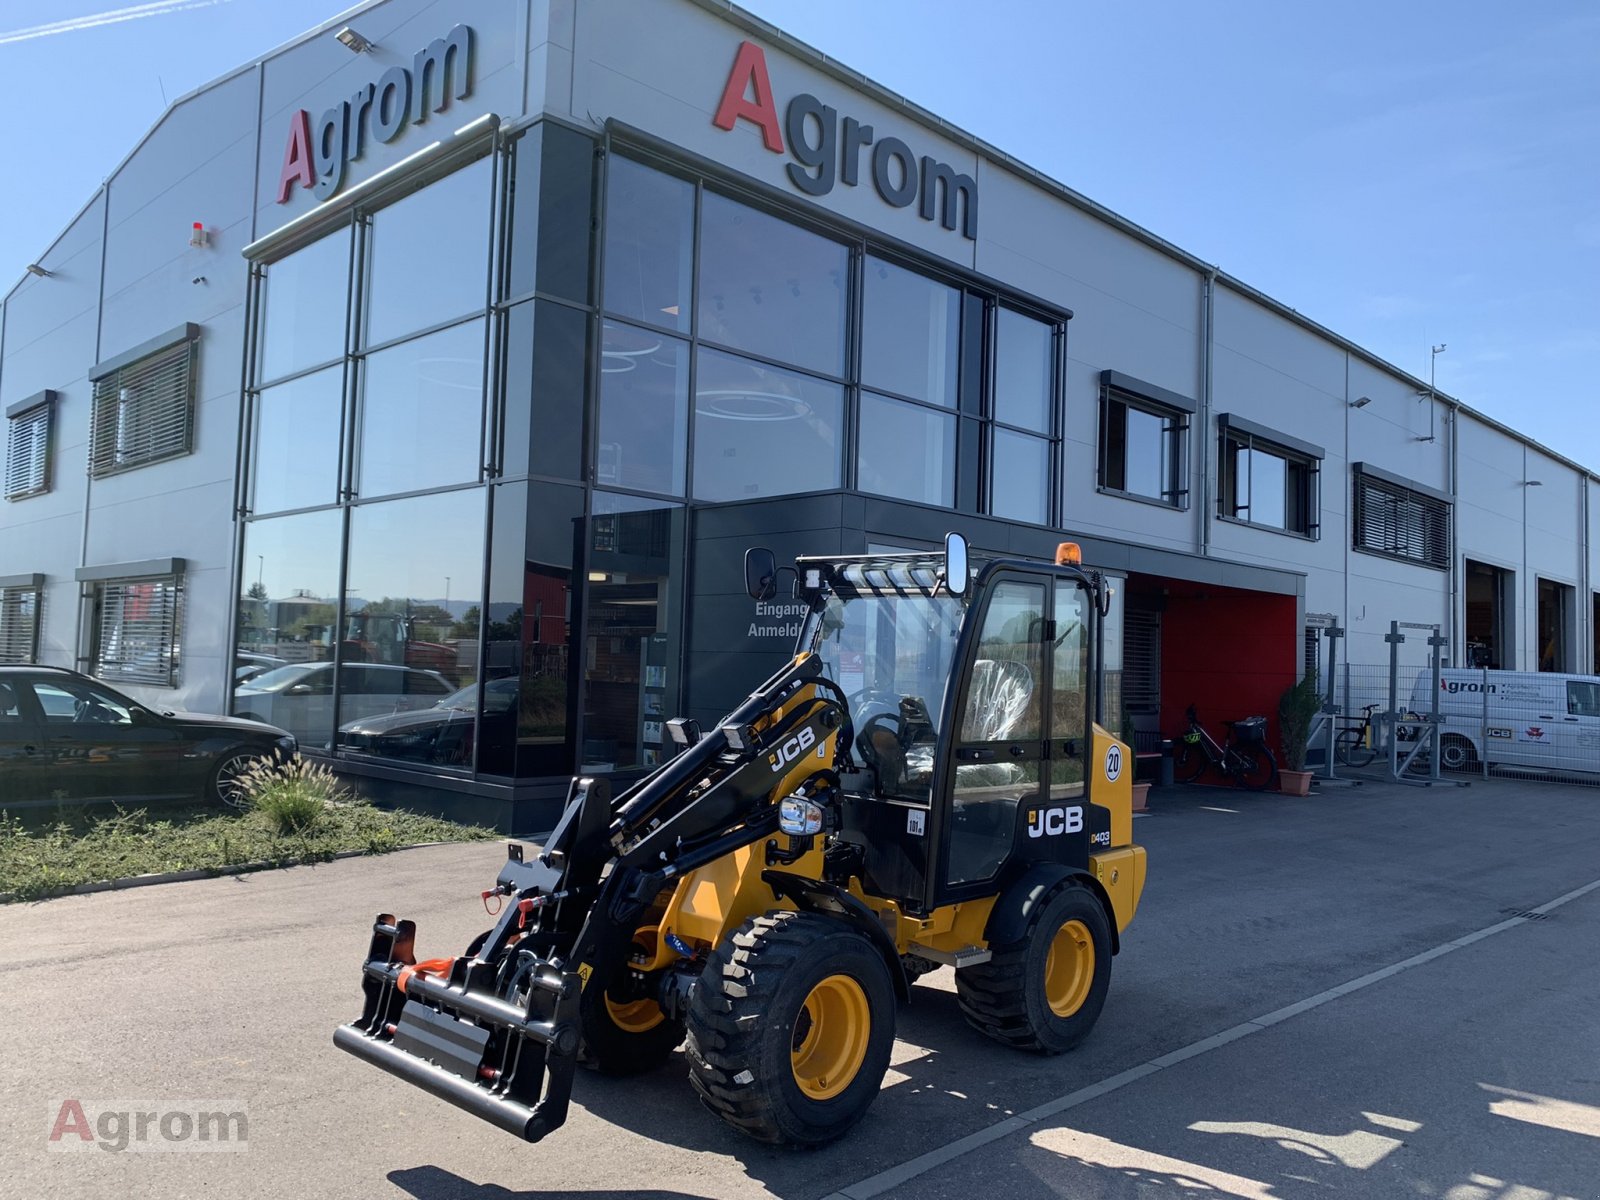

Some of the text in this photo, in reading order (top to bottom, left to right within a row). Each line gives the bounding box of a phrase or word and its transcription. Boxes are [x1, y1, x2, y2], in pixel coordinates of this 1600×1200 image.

[277, 23, 474, 204] Agrom
[712, 40, 978, 240] Agrom
[756, 601, 808, 619] Eingang
[1487, 728, 1511, 738] JCB
[770, 726, 816, 772] JCB
[1107, 753, 1119, 773] 20
[1028, 805, 1083, 838] JCB
[1091, 831, 1110, 844] D403
